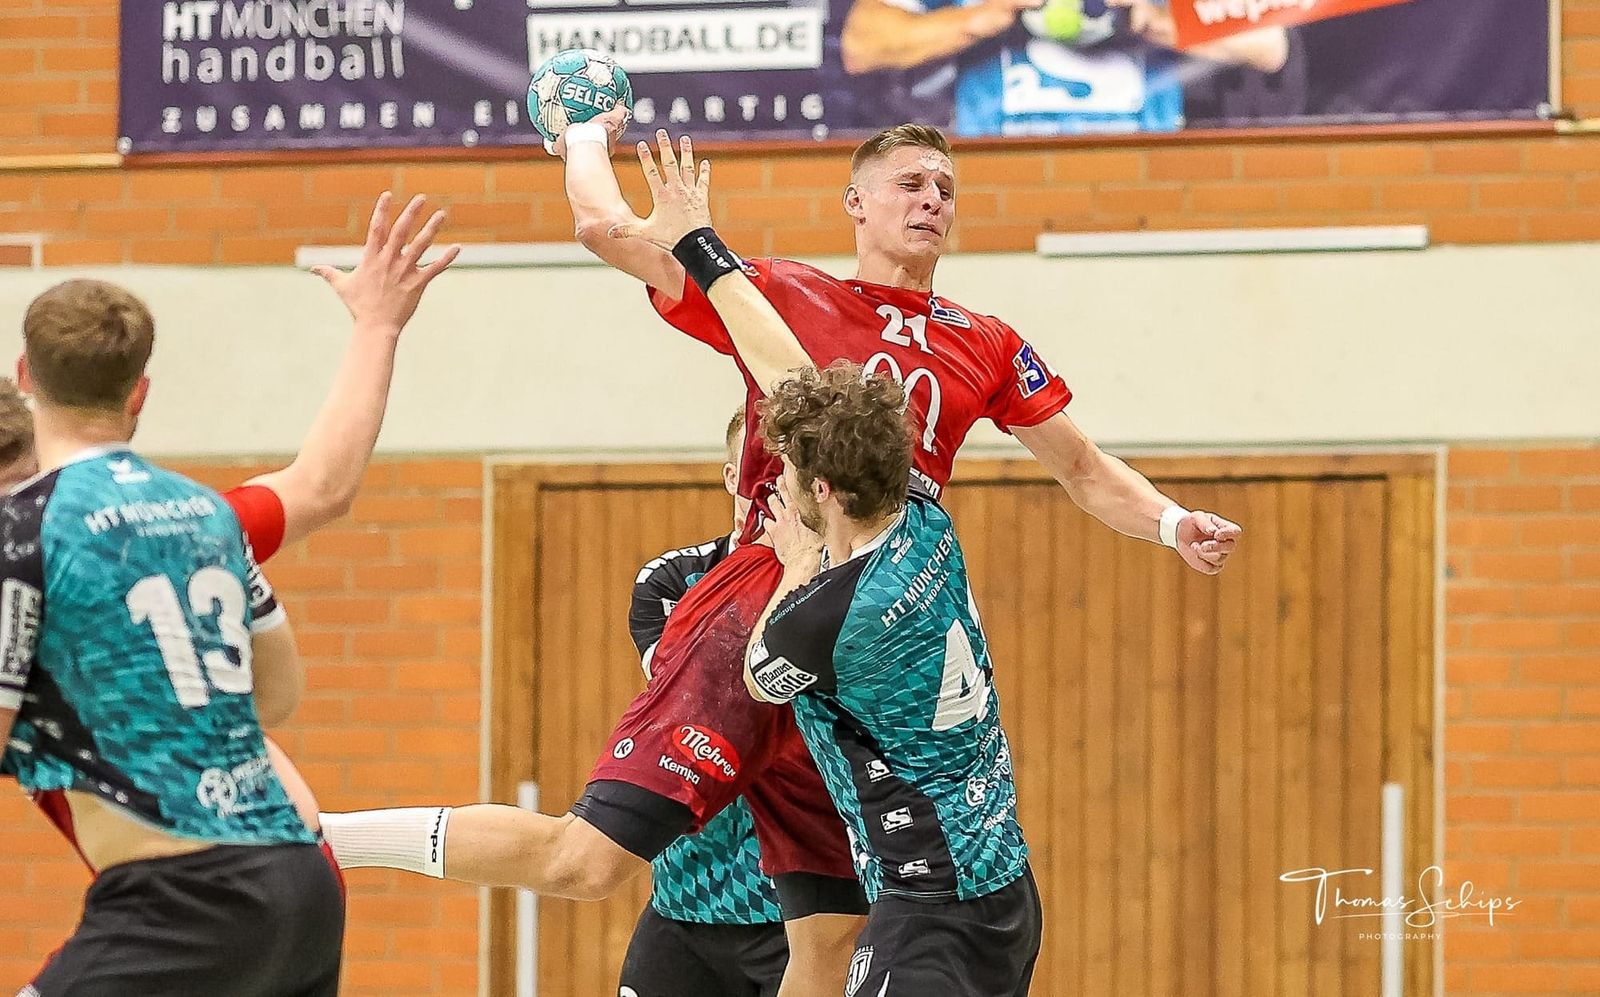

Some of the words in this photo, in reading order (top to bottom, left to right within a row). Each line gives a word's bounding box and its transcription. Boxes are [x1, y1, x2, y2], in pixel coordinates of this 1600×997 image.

[163, 0, 220, 41] HT
[162, 36, 404, 84] handball
[162, 101, 435, 133] ZUSAMMEN
[474, 93, 824, 127] EIGARTIG
[562, 82, 615, 112] SELEC
[875, 304, 934, 355] 21
[881, 599, 906, 628] HT
[903, 527, 955, 606] MÜNCHEN
[919, 569, 950, 612] HANDBALL
[125, 566, 253, 709] 13
[768, 672, 813, 697] Kölle
[931, 618, 991, 732] 4
[658, 755, 701, 785] Kempa
